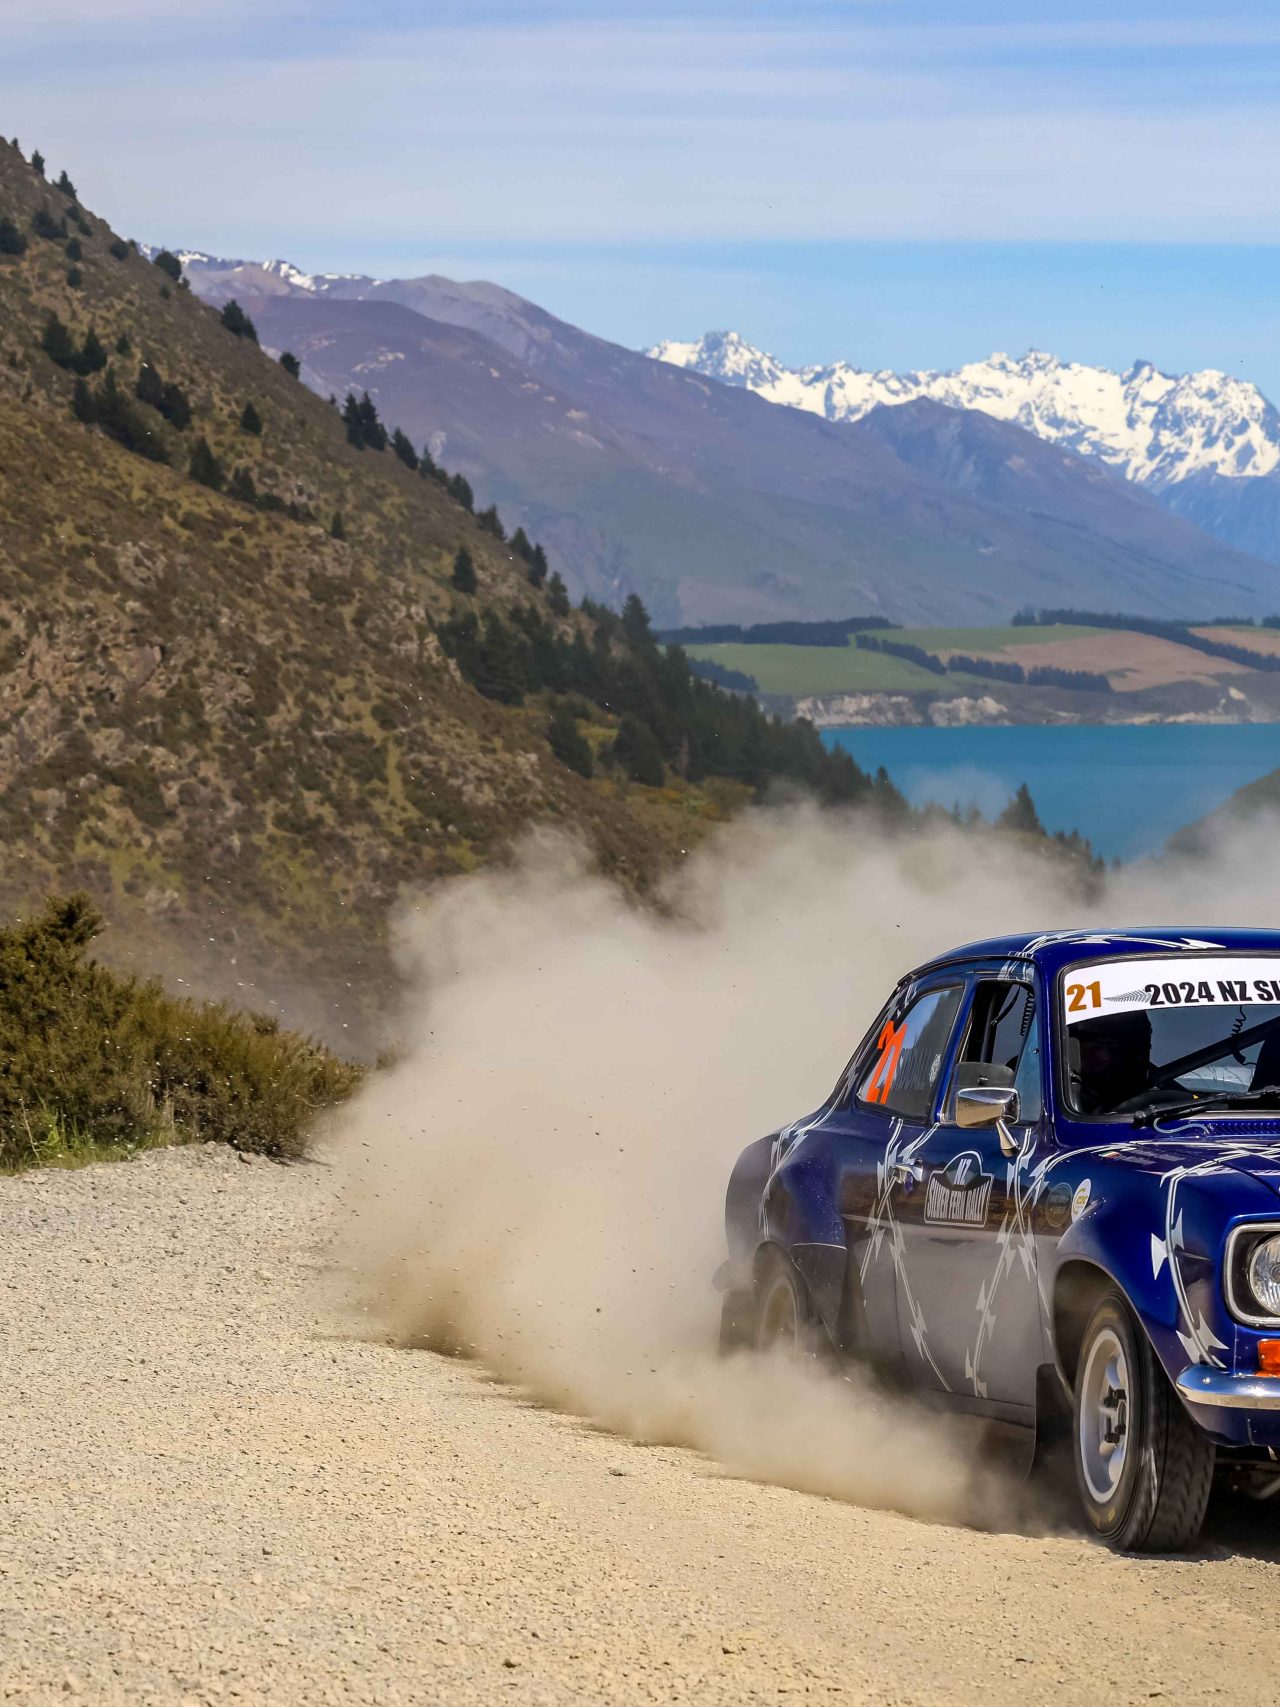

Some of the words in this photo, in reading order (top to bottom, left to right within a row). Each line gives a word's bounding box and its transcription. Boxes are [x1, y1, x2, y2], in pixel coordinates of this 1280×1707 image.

[1066, 981, 1102, 1012] 21
[1145, 981, 1215, 1006] 2024
[1216, 980, 1253, 1002] NZ
[953, 1158, 973, 1186] NZ
[927, 1177, 951, 1219] SILVER
[948, 1190, 968, 1220] FERN
[965, 1180, 991, 1222] RALLY
